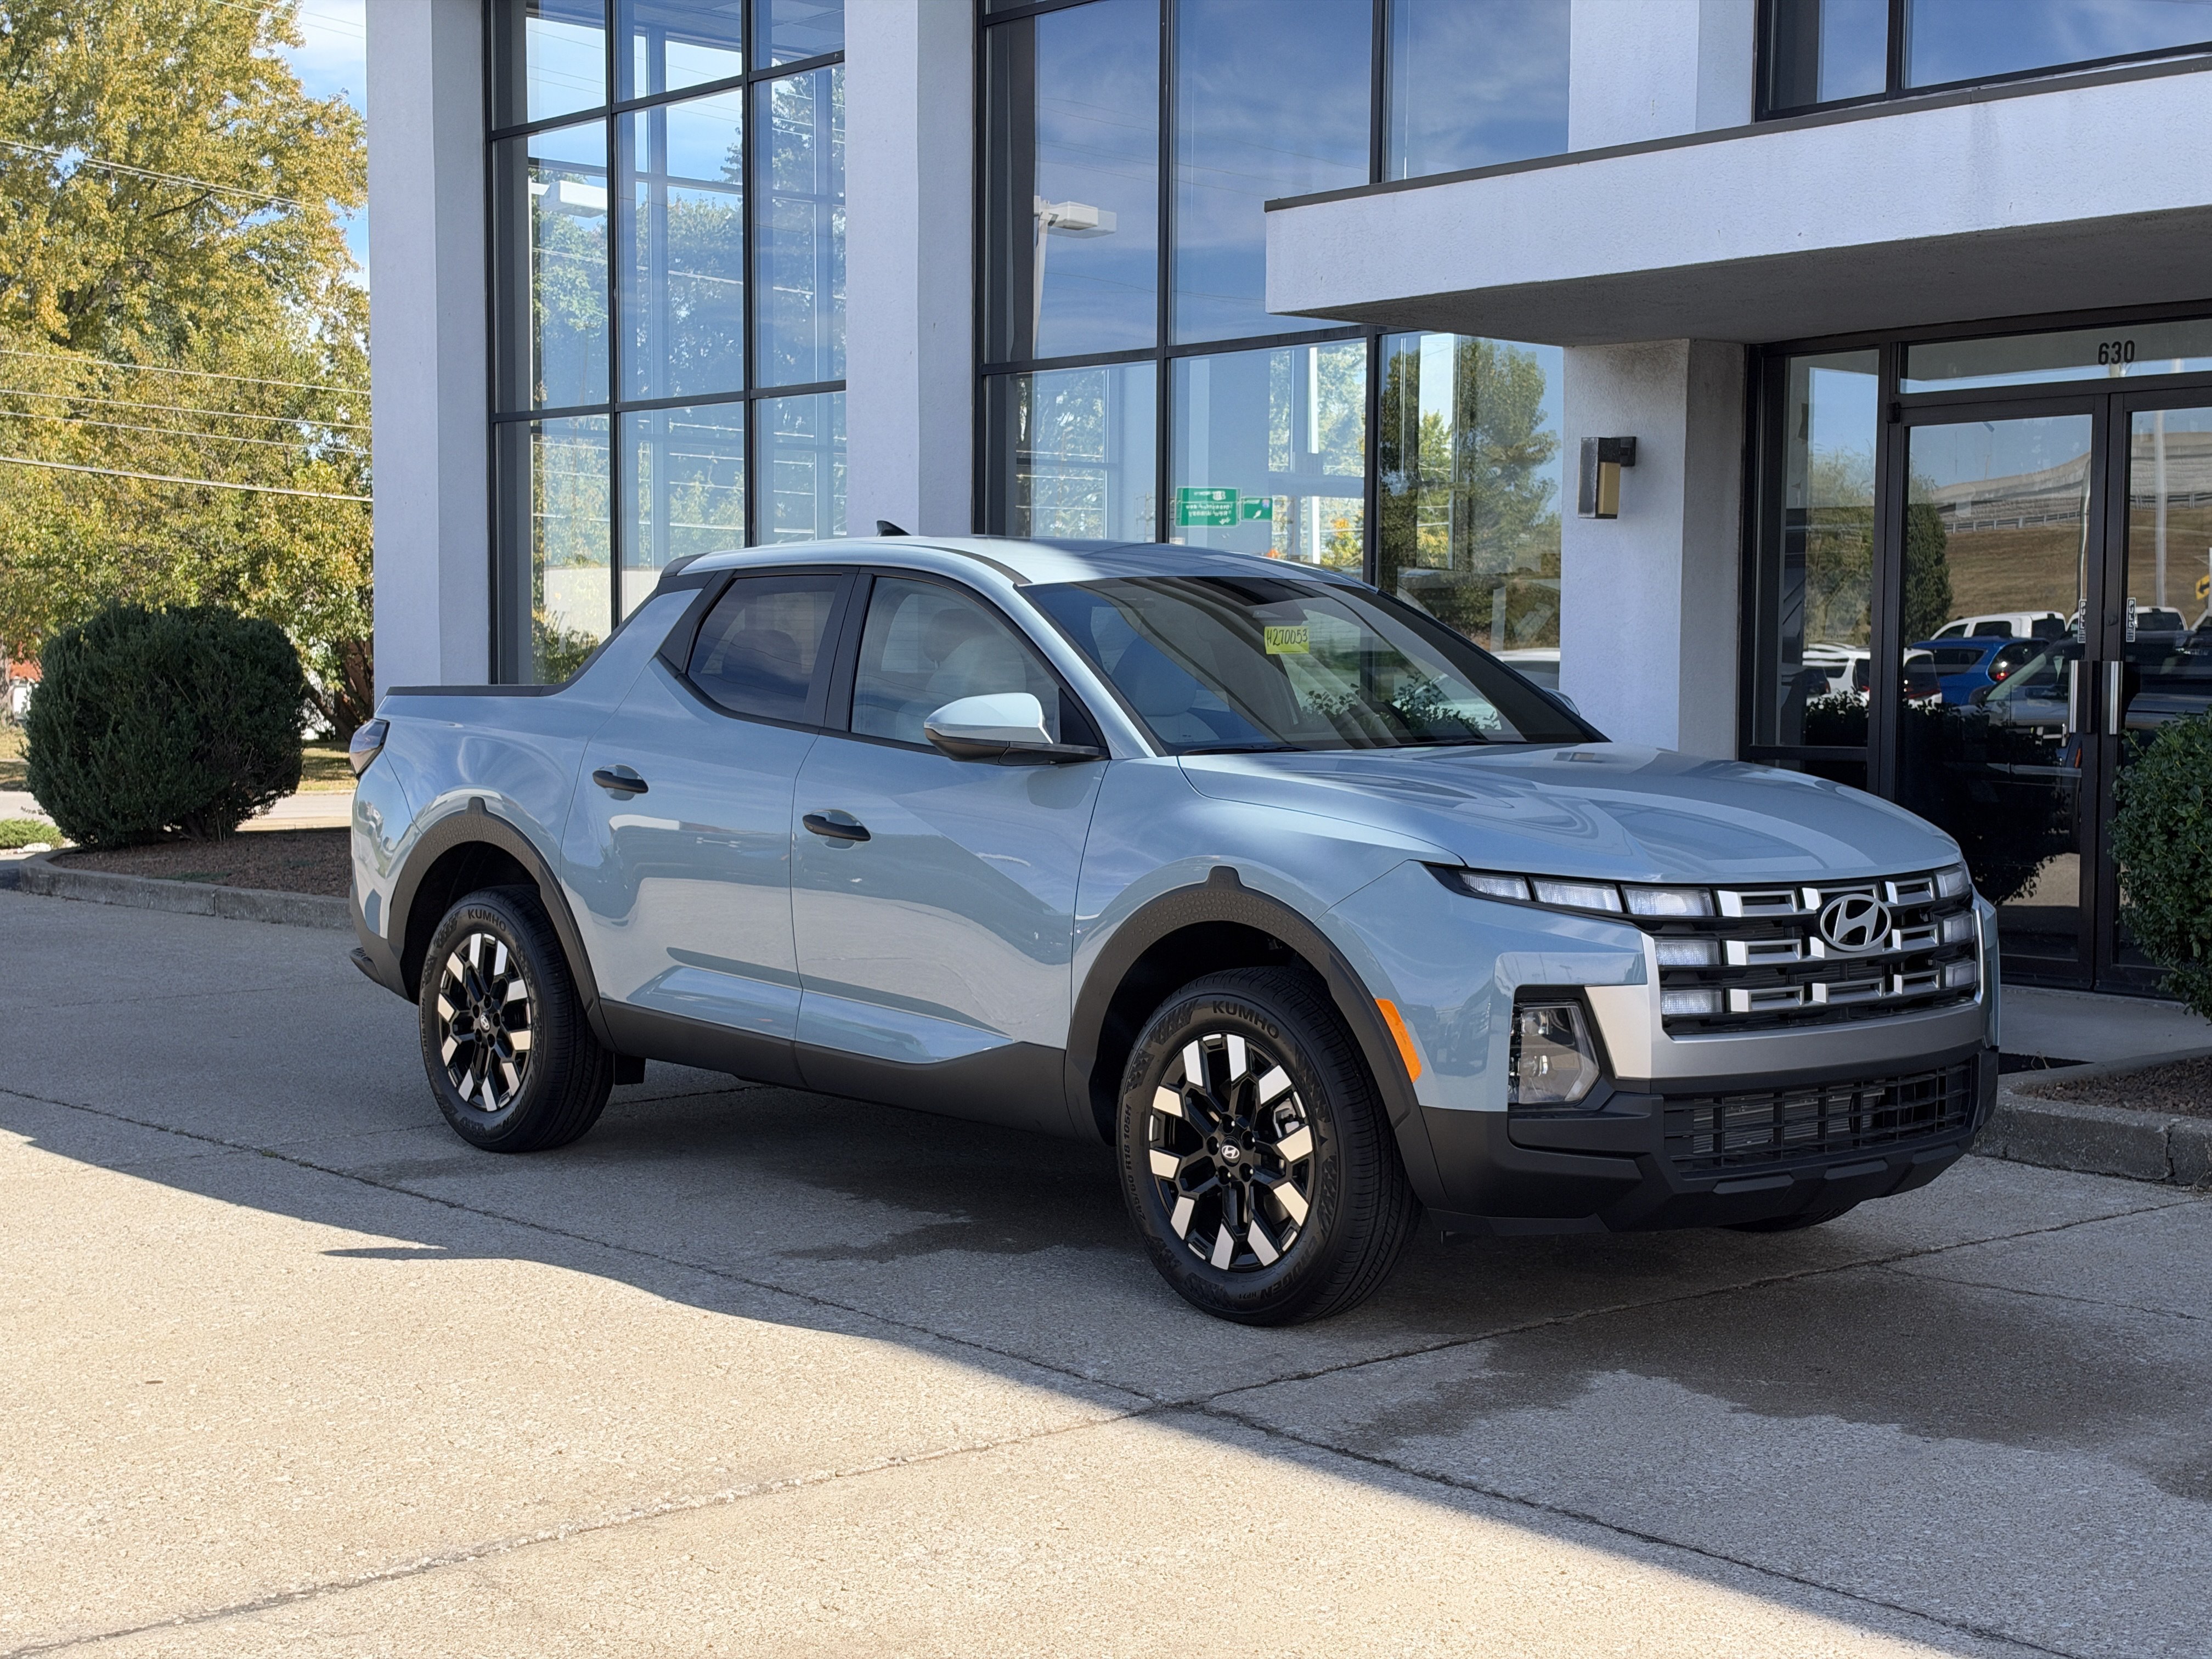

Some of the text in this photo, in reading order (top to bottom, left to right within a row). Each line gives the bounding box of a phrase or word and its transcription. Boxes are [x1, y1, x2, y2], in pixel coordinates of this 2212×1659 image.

[2098, 340, 2135, 365] 630
[1266, 628, 1308, 647] H270053
[467, 908, 506, 932] KUMHO
[1212, 1000, 1279, 1039] KUMHO
